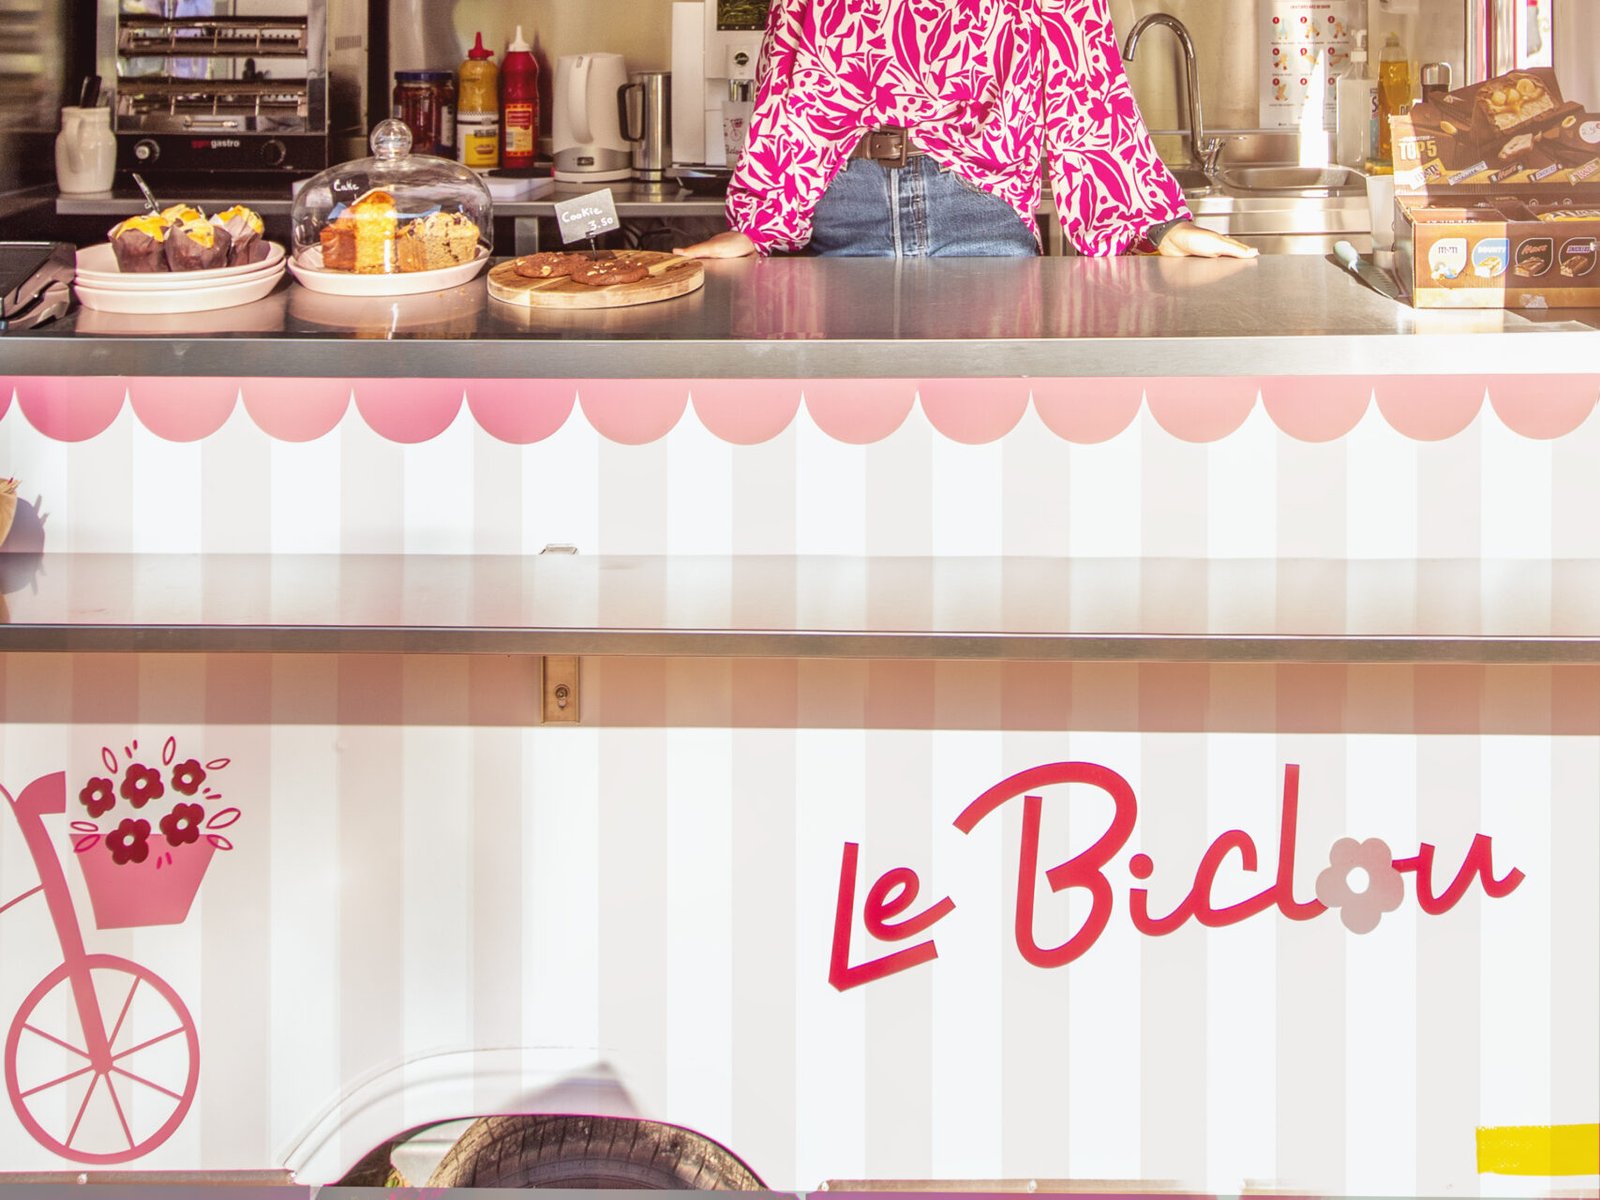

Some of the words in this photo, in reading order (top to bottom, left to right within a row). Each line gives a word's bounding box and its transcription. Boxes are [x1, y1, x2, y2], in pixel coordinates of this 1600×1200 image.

[1399, 141, 1425, 160] TOP
[1427, 140, 1438, 157] 5
[588, 217, 614, 231] 3.50
[828, 841, 956, 992] Le
